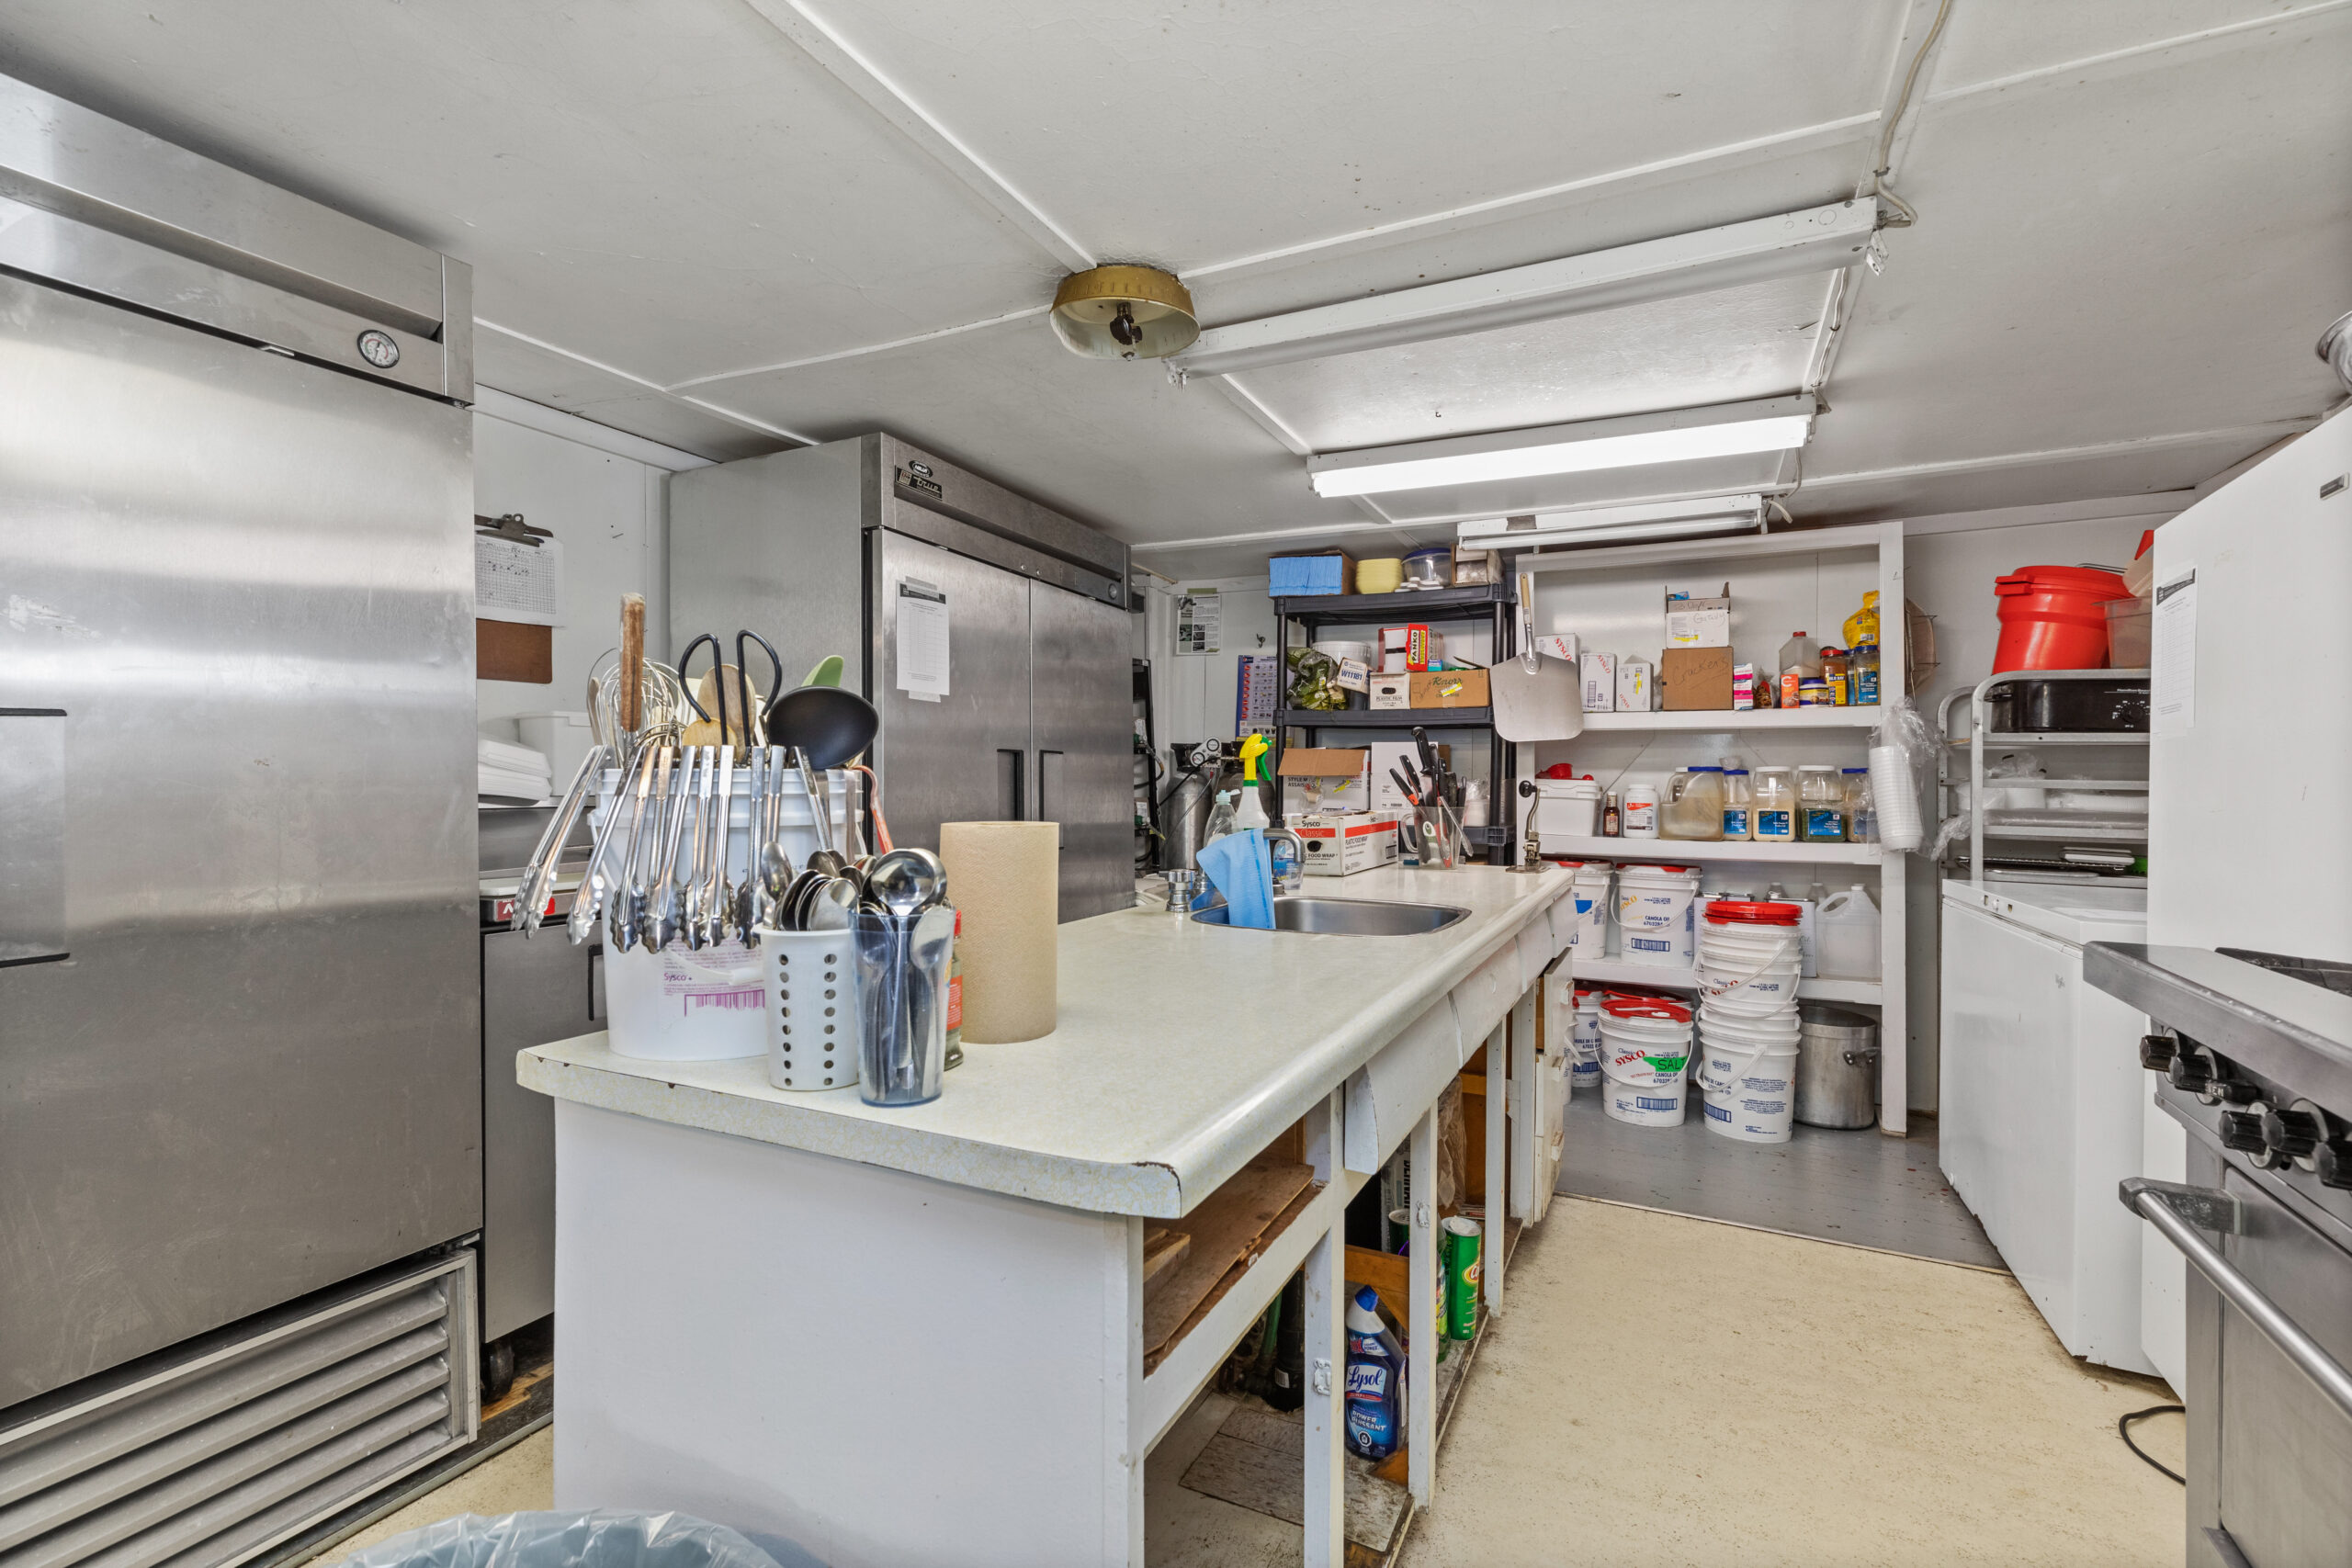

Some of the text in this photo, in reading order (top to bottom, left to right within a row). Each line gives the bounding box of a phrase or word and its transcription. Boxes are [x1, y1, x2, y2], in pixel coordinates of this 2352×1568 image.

[1301, 819, 1321, 828] Sysco
[1300, 829, 1324, 838] Classic
[663, 972, 687, 982] Sysco
[1614, 1049, 1646, 1066] SYSCO
[1617, 1047, 1636, 1056] Classic
[1348, 1366, 1384, 1390] Lysol
[1352, 1410, 1377, 1424] POWER
[1351, 1417, 1386, 1432] PUISSANT
